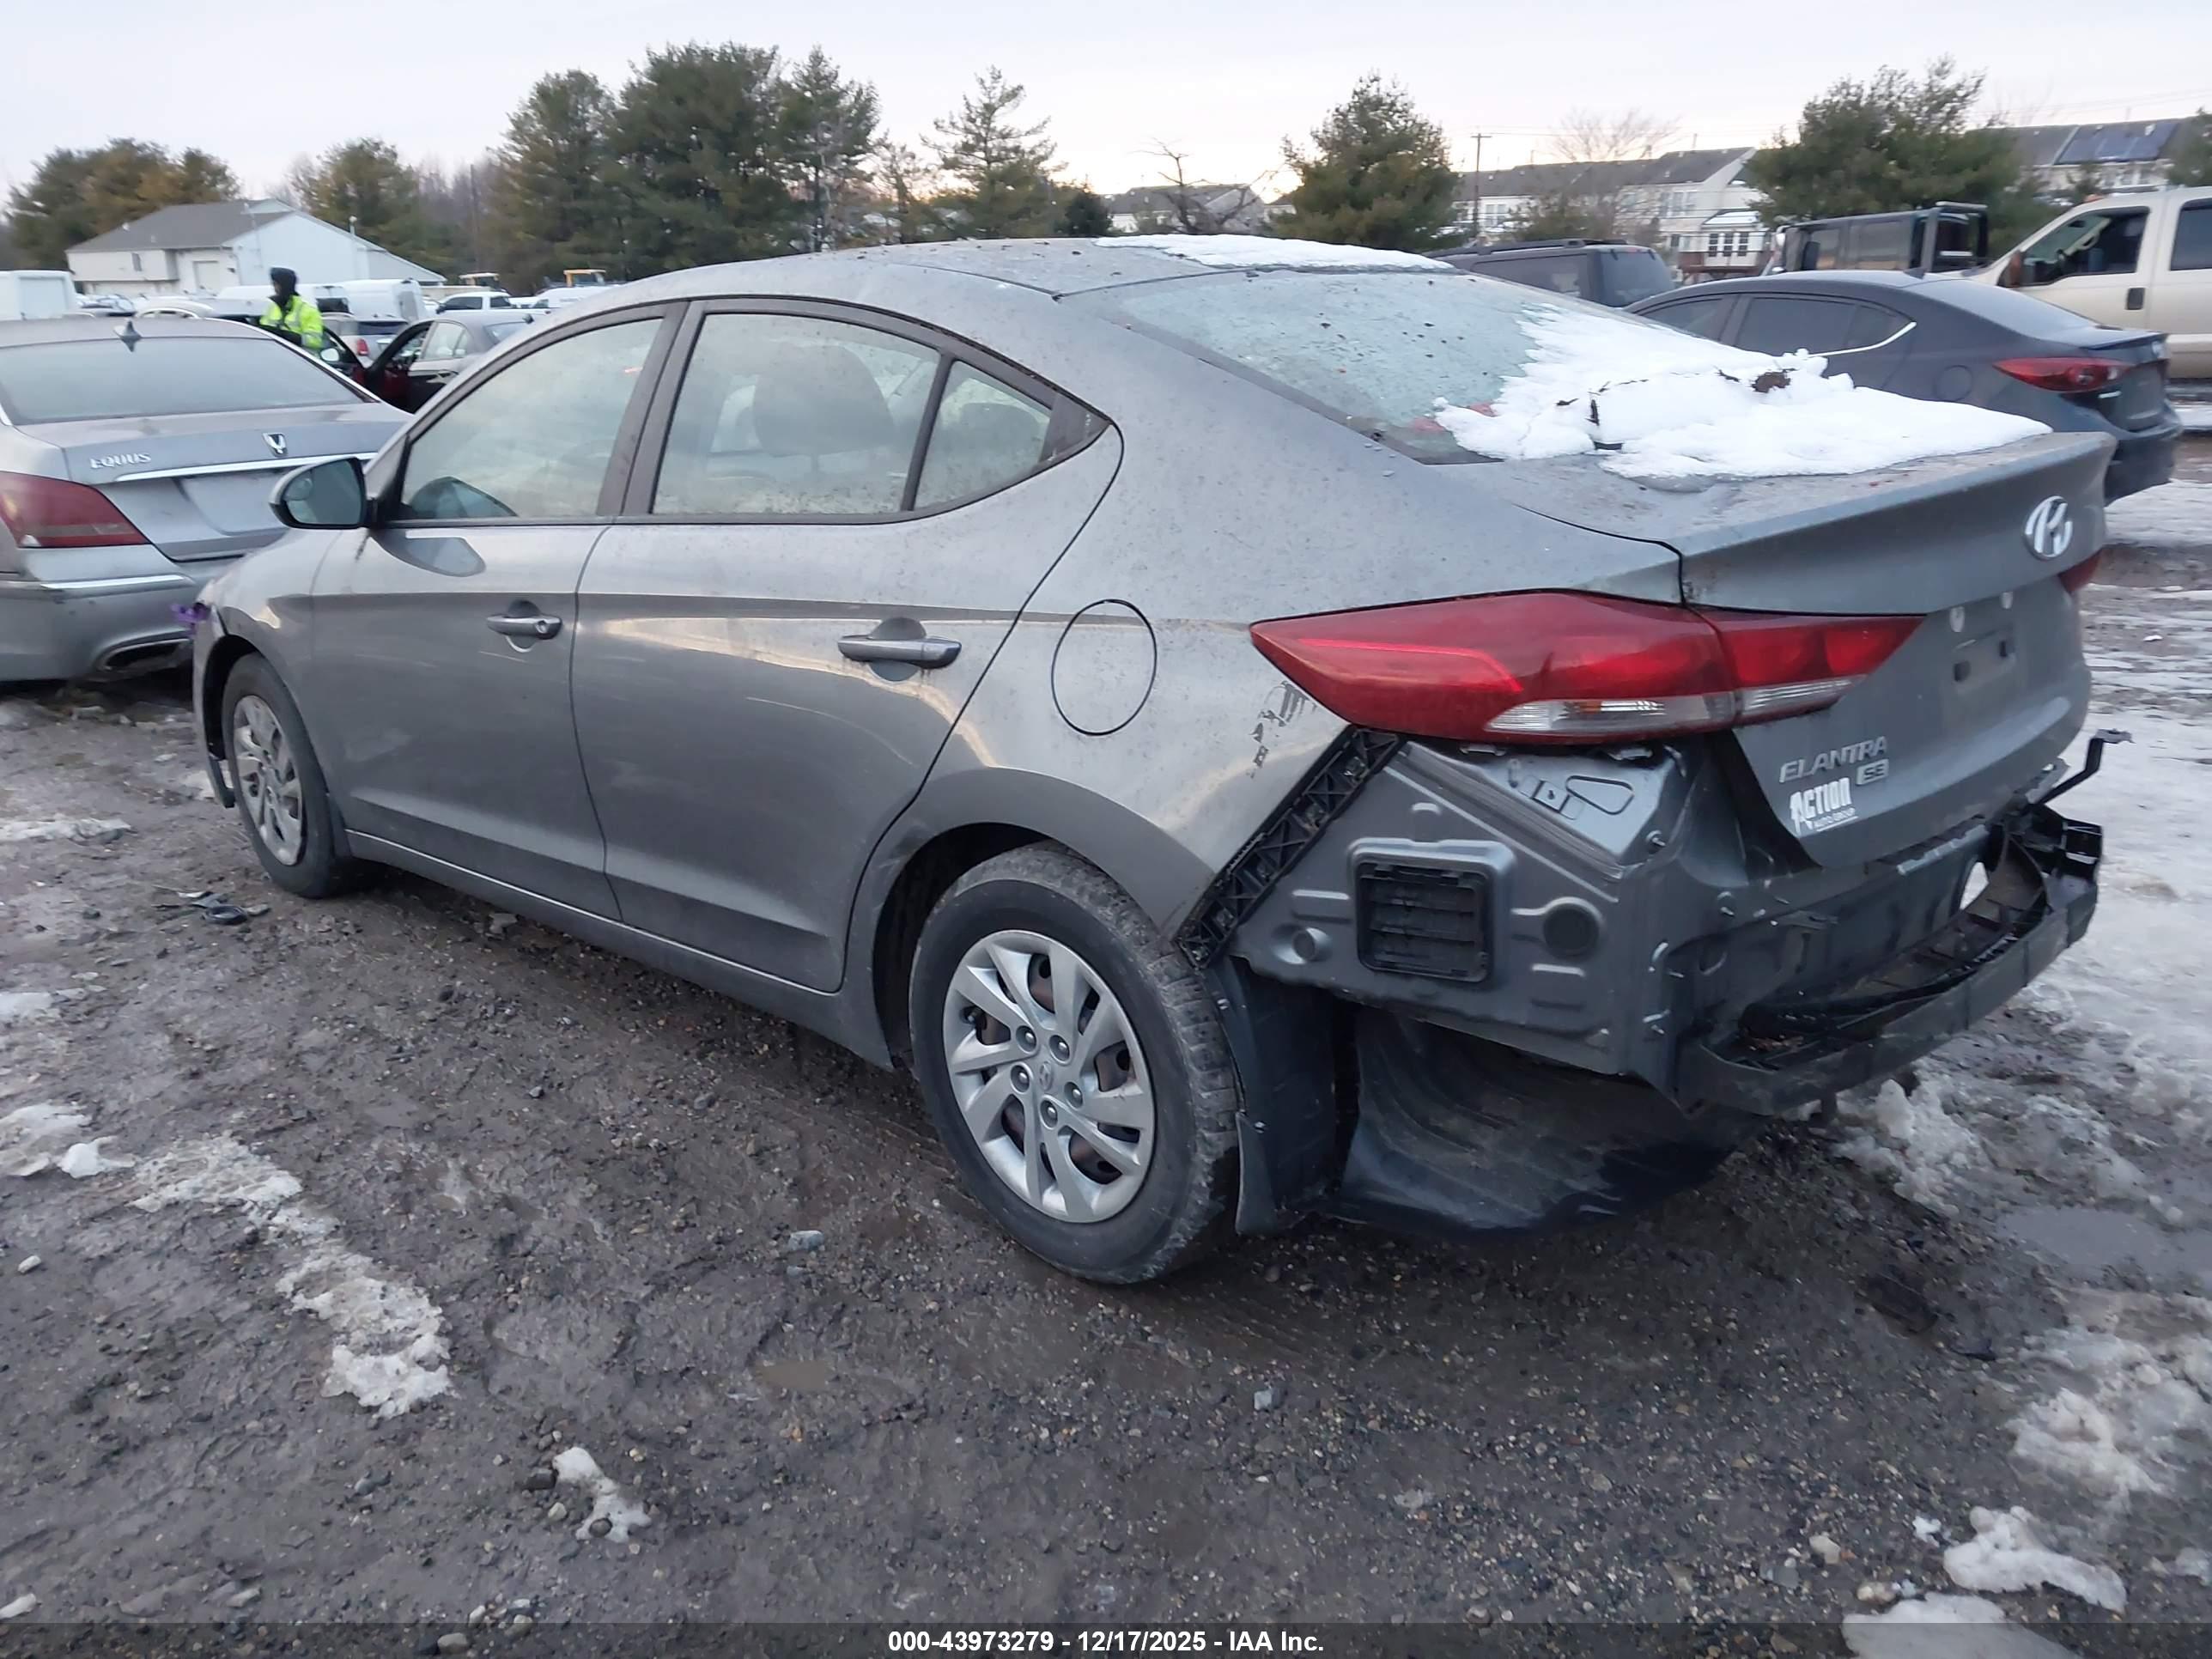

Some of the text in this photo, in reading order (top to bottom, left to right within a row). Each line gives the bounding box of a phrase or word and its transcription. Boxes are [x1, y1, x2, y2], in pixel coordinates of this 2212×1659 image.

[90, 453, 152, 469] EQUUS
[1778, 736, 1887, 783] ELANTRA
[1790, 777, 1852, 834] ACTION
